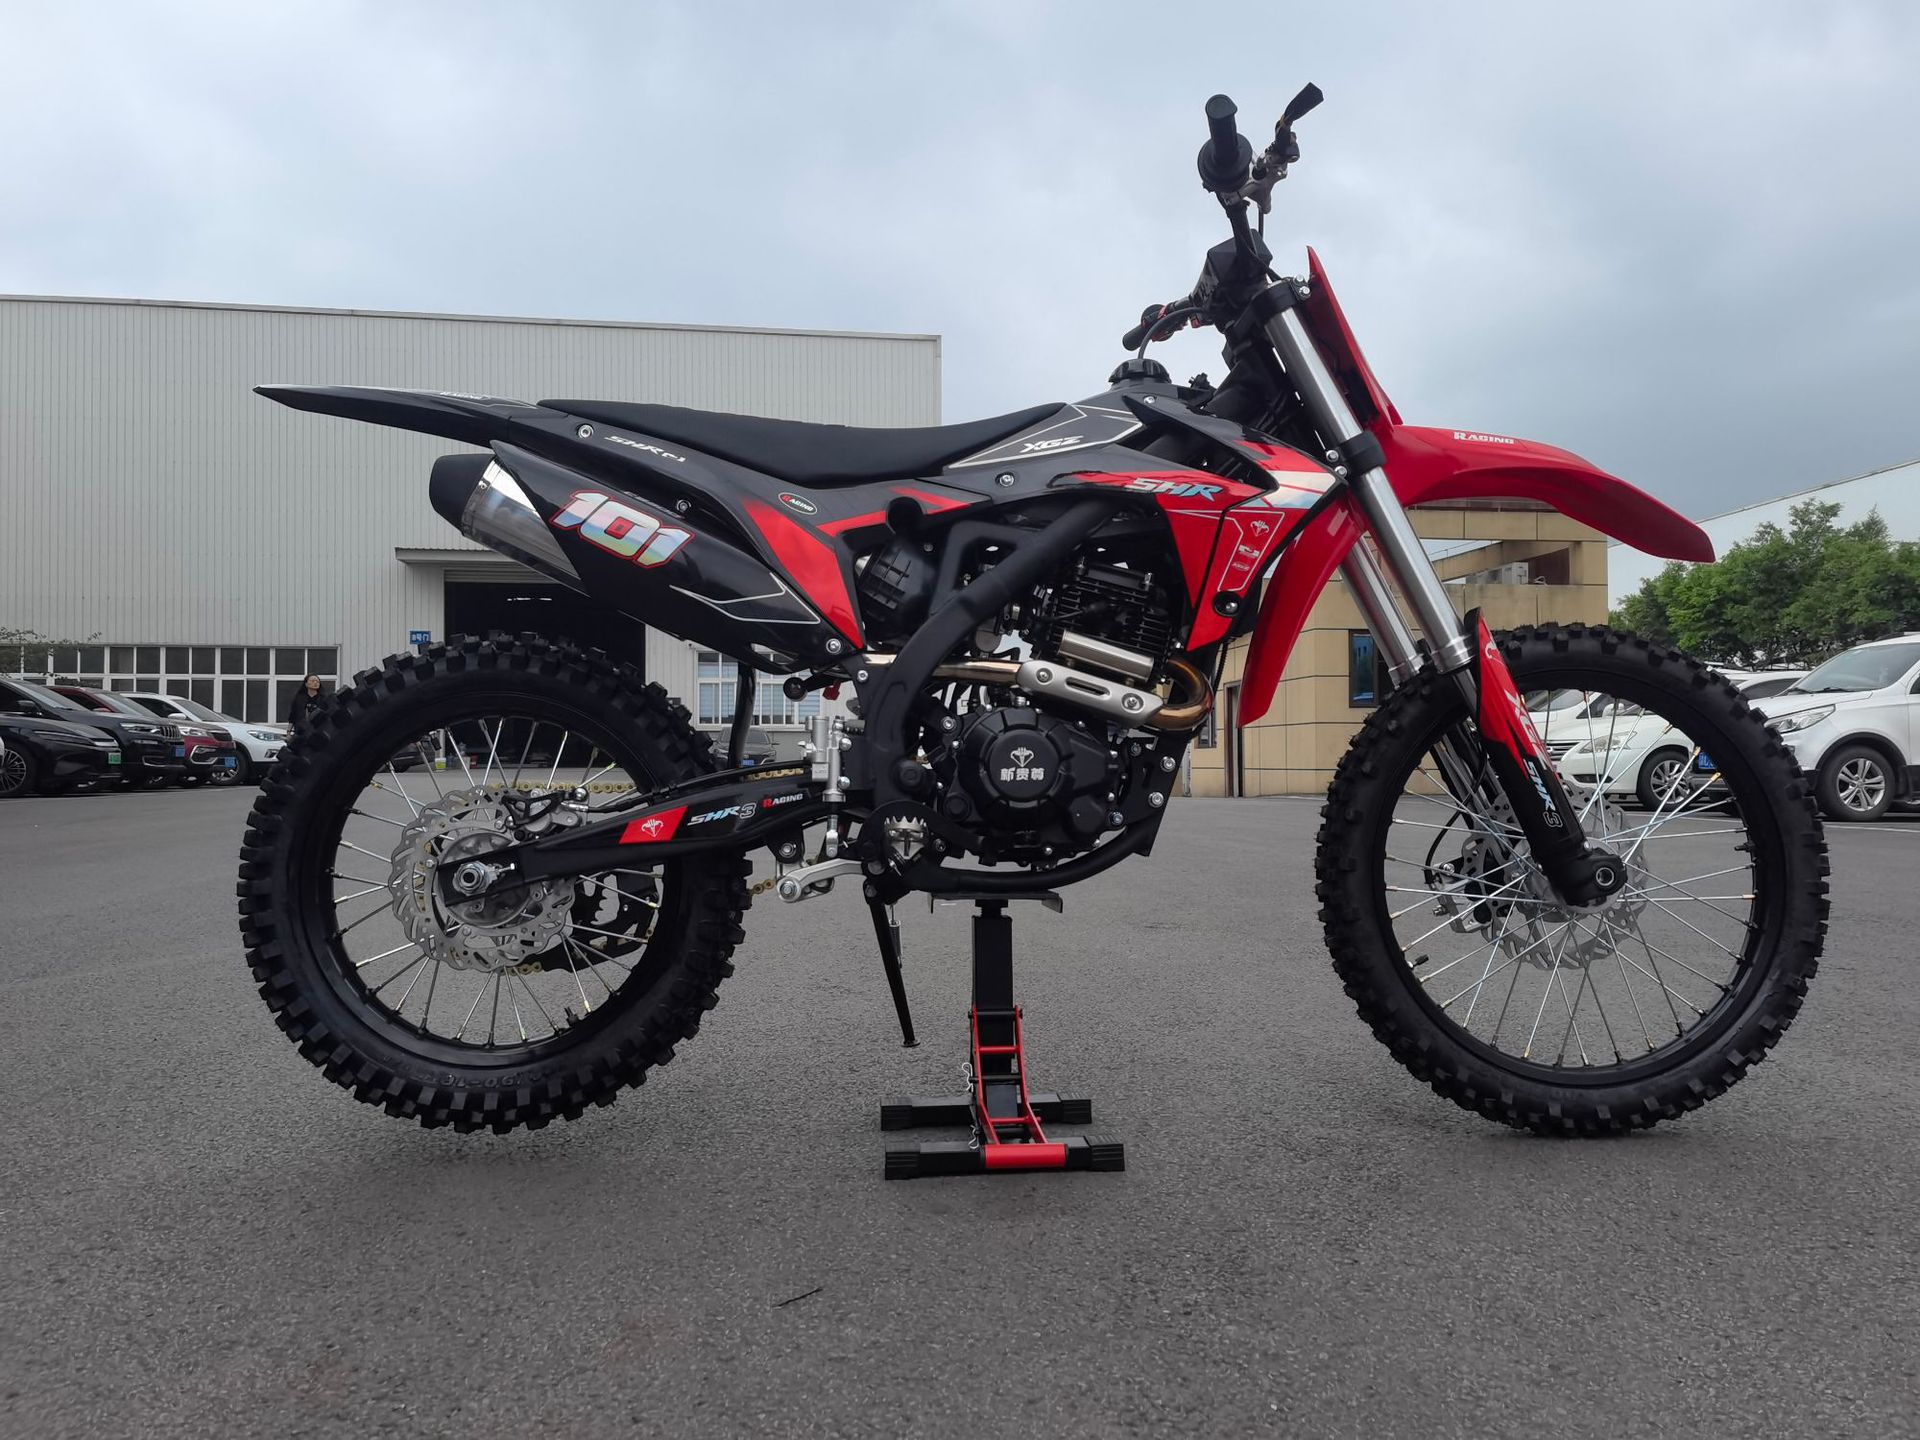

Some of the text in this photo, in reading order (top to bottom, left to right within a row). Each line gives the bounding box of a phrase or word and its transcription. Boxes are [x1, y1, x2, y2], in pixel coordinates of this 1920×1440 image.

[1453, 431, 1515, 444] RACING
[1123, 477, 1223, 502] SHR
[782, 494, 814, 512] RACING
[549, 489, 696, 569] 101
[761, 793, 803, 809] RACING
